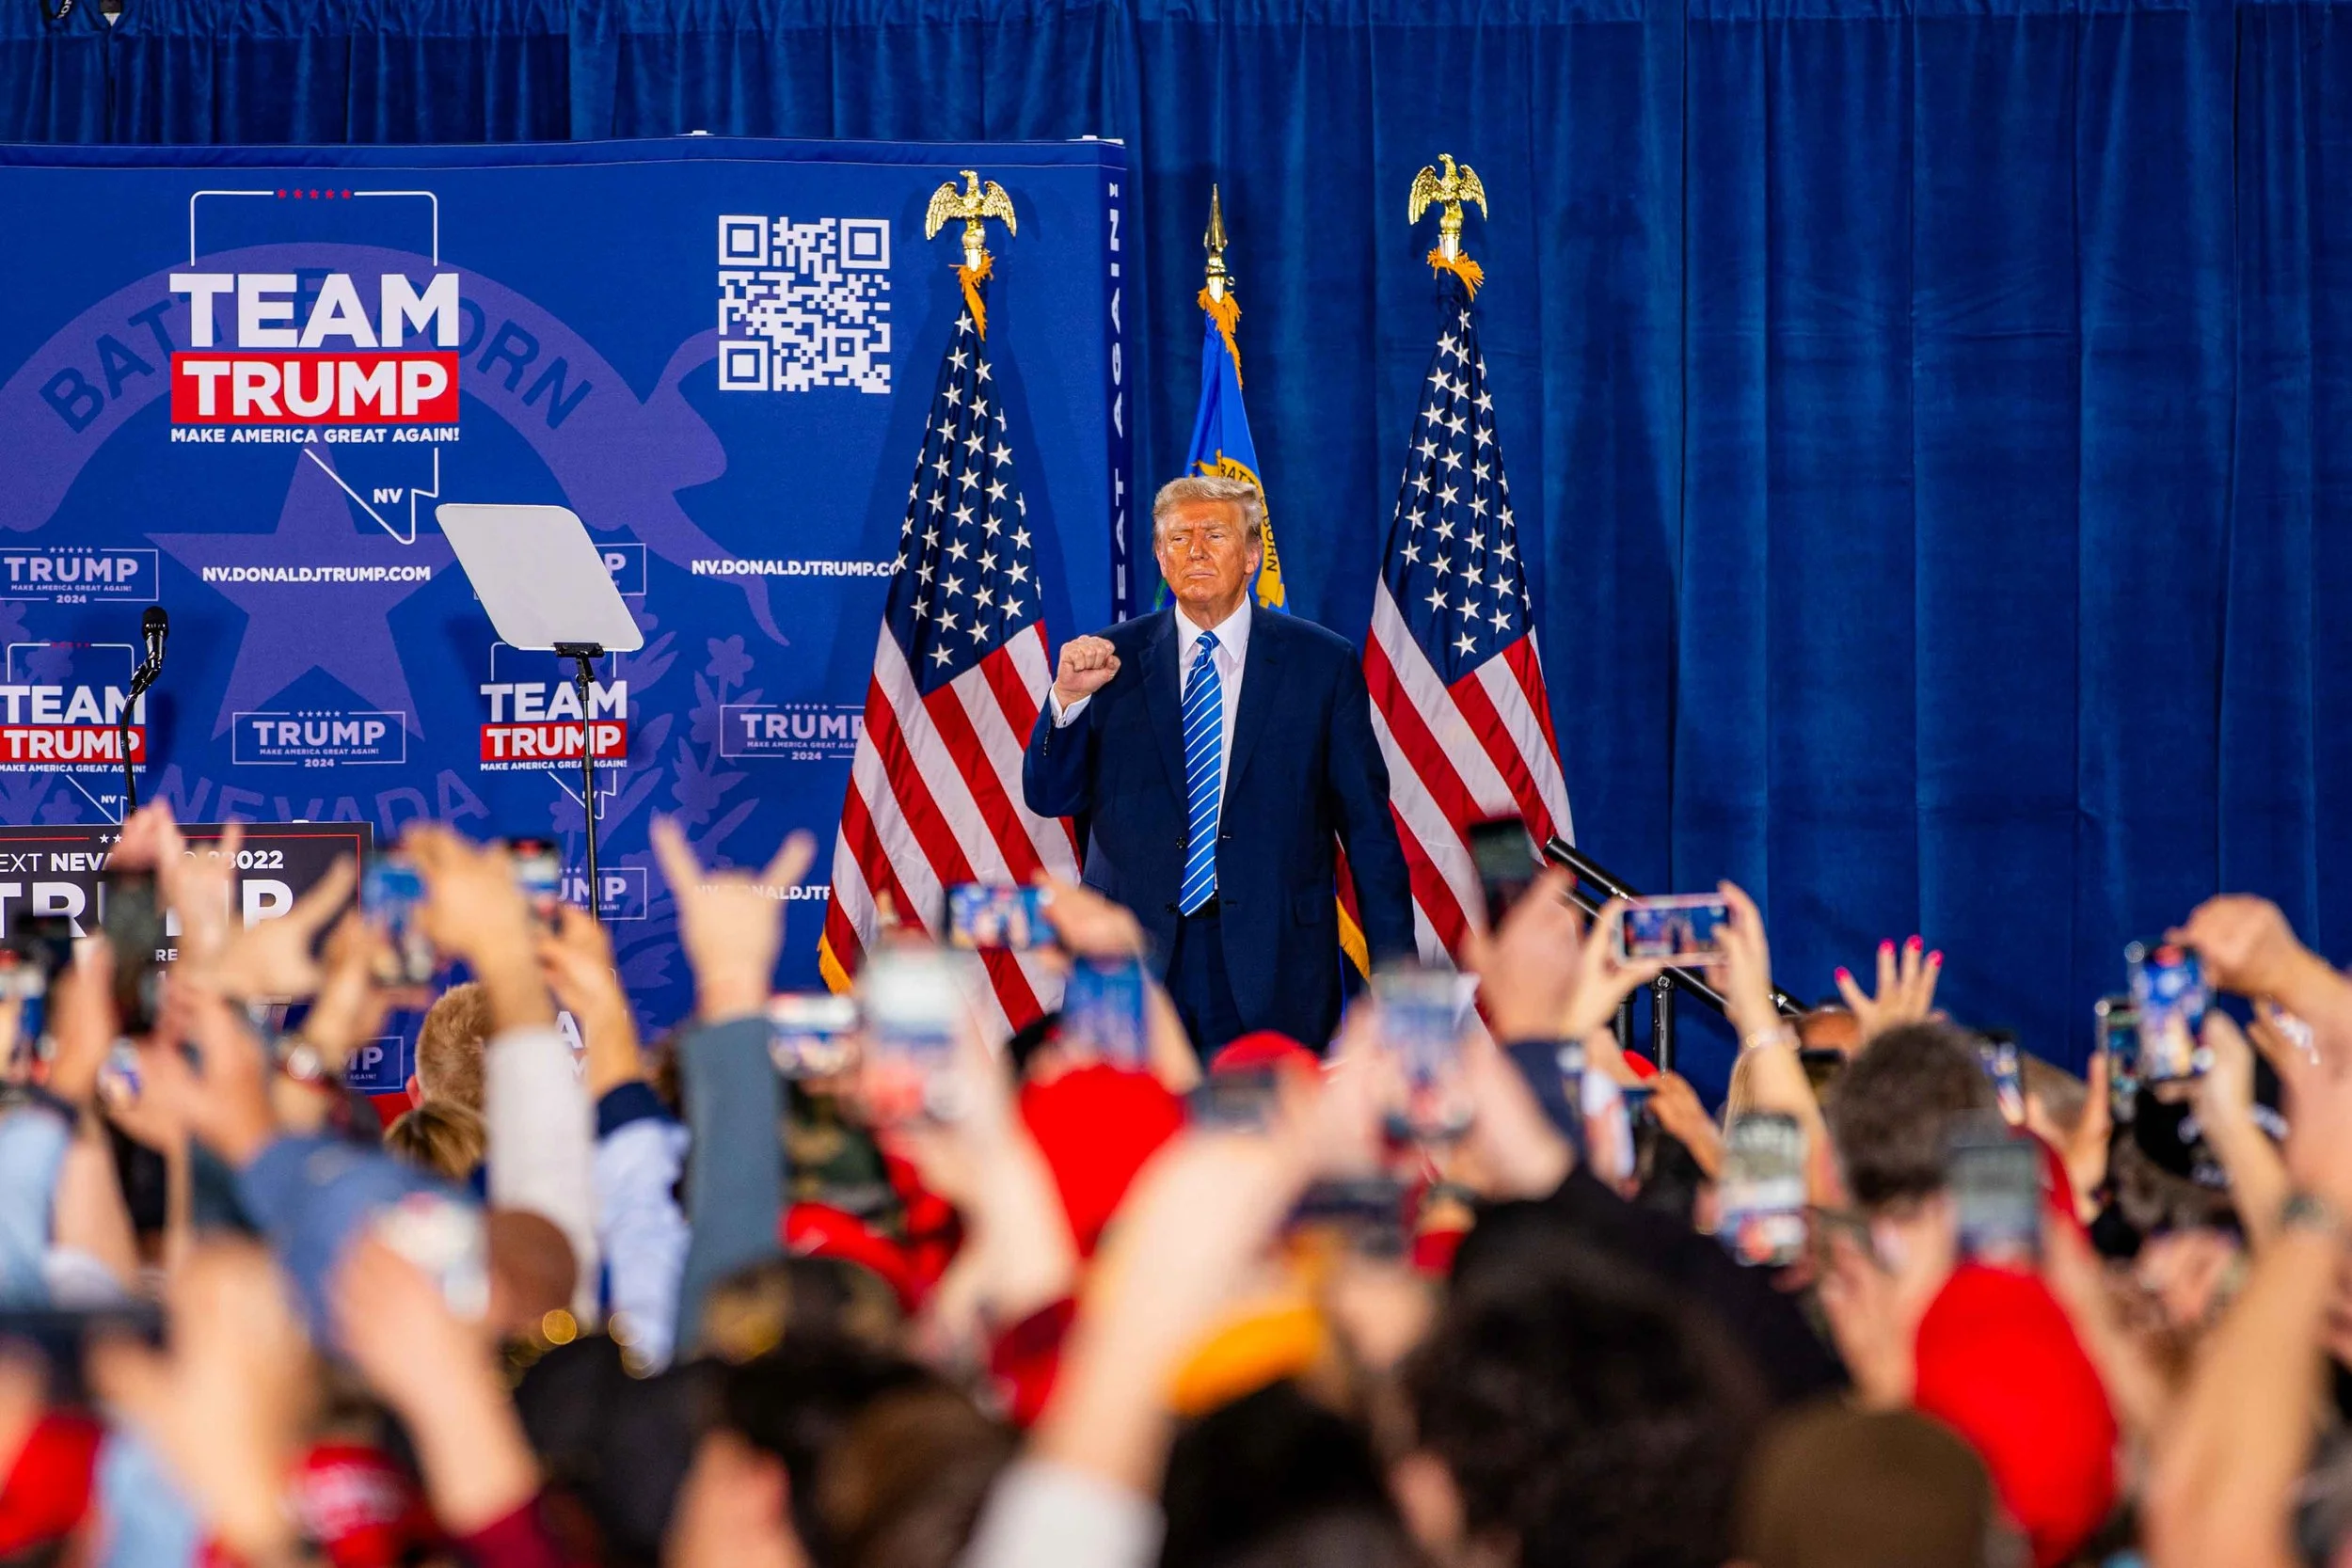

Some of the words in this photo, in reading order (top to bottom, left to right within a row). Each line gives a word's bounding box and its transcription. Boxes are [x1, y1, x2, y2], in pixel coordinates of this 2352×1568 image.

[169, 273, 459, 347] TEAM
[183, 360, 449, 418] TRUMP
[171, 429, 226, 443] MAKE
[230, 429, 319, 443] AMERICA
[324, 429, 387, 443] GREAT
[392, 428, 460, 442] AGAIN!
[373, 488, 403, 503] NV
[4, 557, 138, 582] TRUMP
[202, 566, 431, 581] NV.DONALDJTRUMP.COM
[56, 594, 87, 604] 2024
[0, 686, 146, 724] TEAM
[480, 680, 628, 722] TEAM
[252, 721, 386, 746] TRUMP
[486, 725, 622, 757] TRUMP
[304, 758, 335, 768] 2024
[791, 752, 822, 761] 2024
[111, 765, 147, 773] AGIN!
[481, 763, 508, 771] MAKE
[511, 762, 554, 770] AMERICA
[557, 761, 583, 769] GREA
[101, 795, 117, 804] NV
[0, 853, 42, 872] EXT
